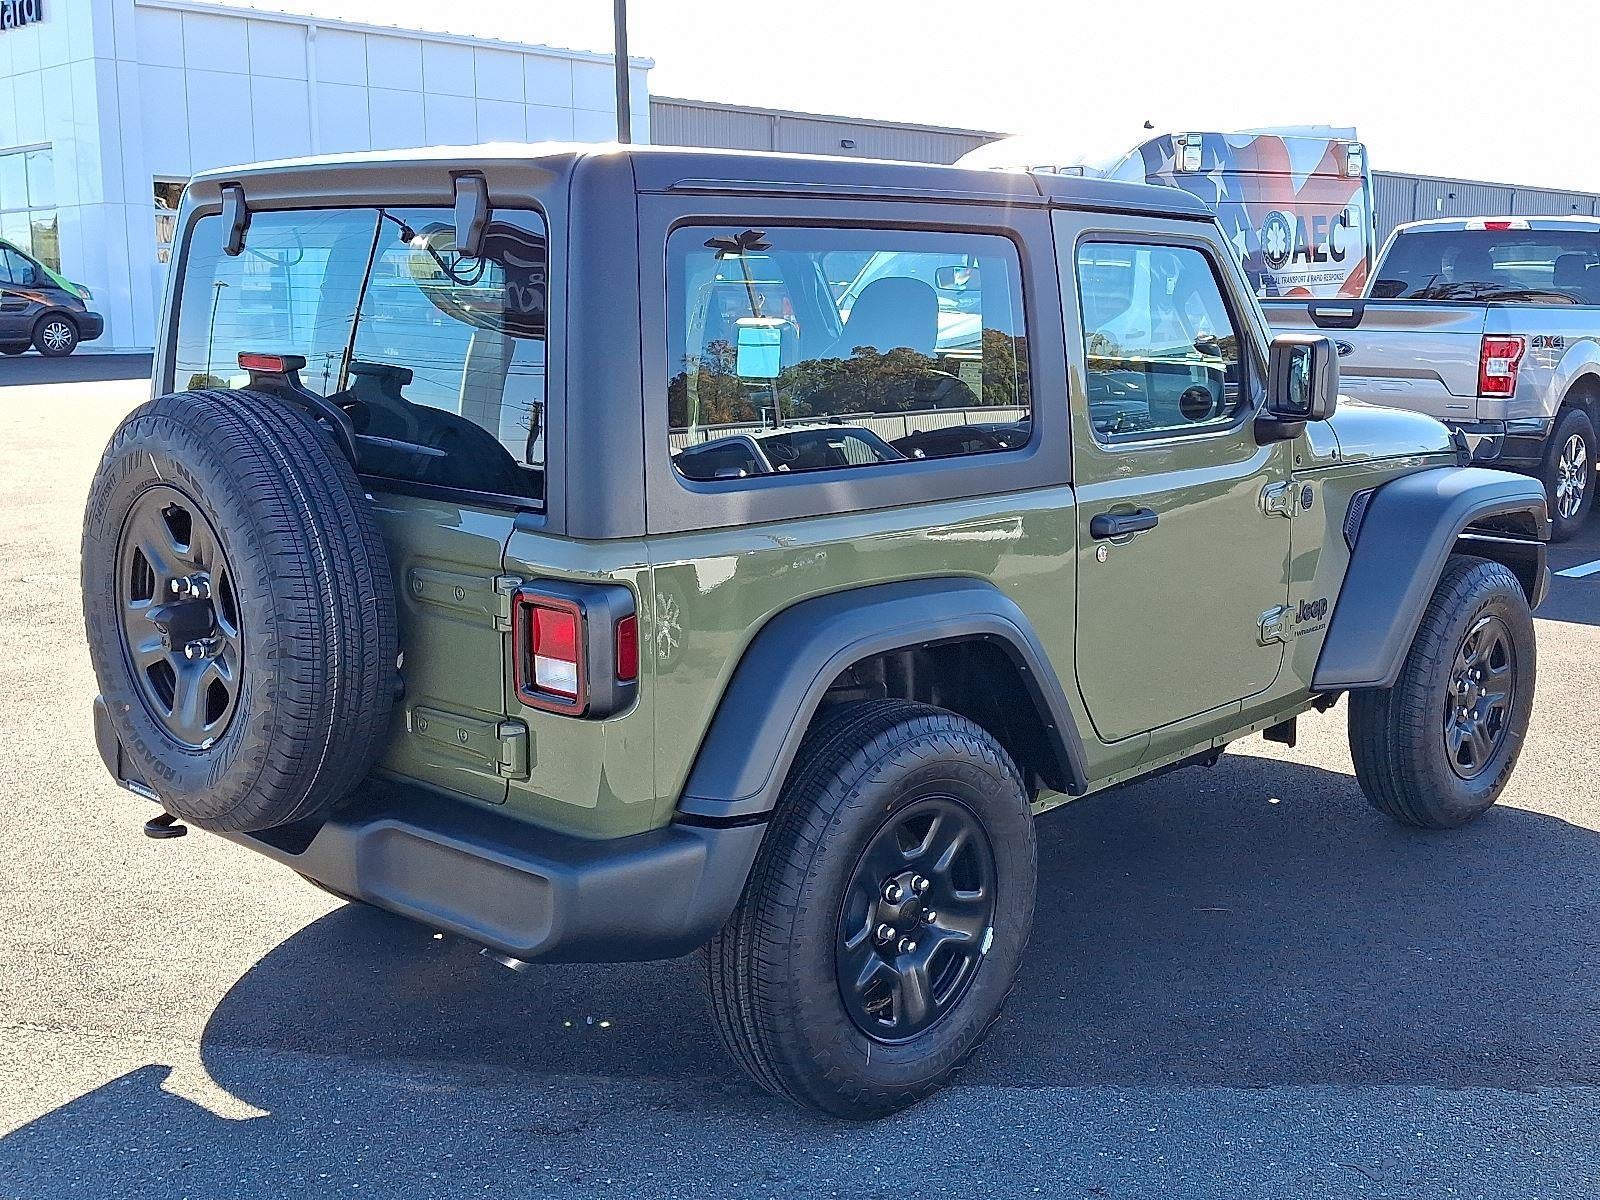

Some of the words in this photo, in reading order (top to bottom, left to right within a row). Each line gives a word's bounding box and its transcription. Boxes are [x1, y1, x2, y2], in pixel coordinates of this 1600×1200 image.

[1281, 275, 1306, 285] TRANSPORT
[1323, 272, 1345, 281] RESPONSE
[1296, 598, 1328, 624] Jeep
